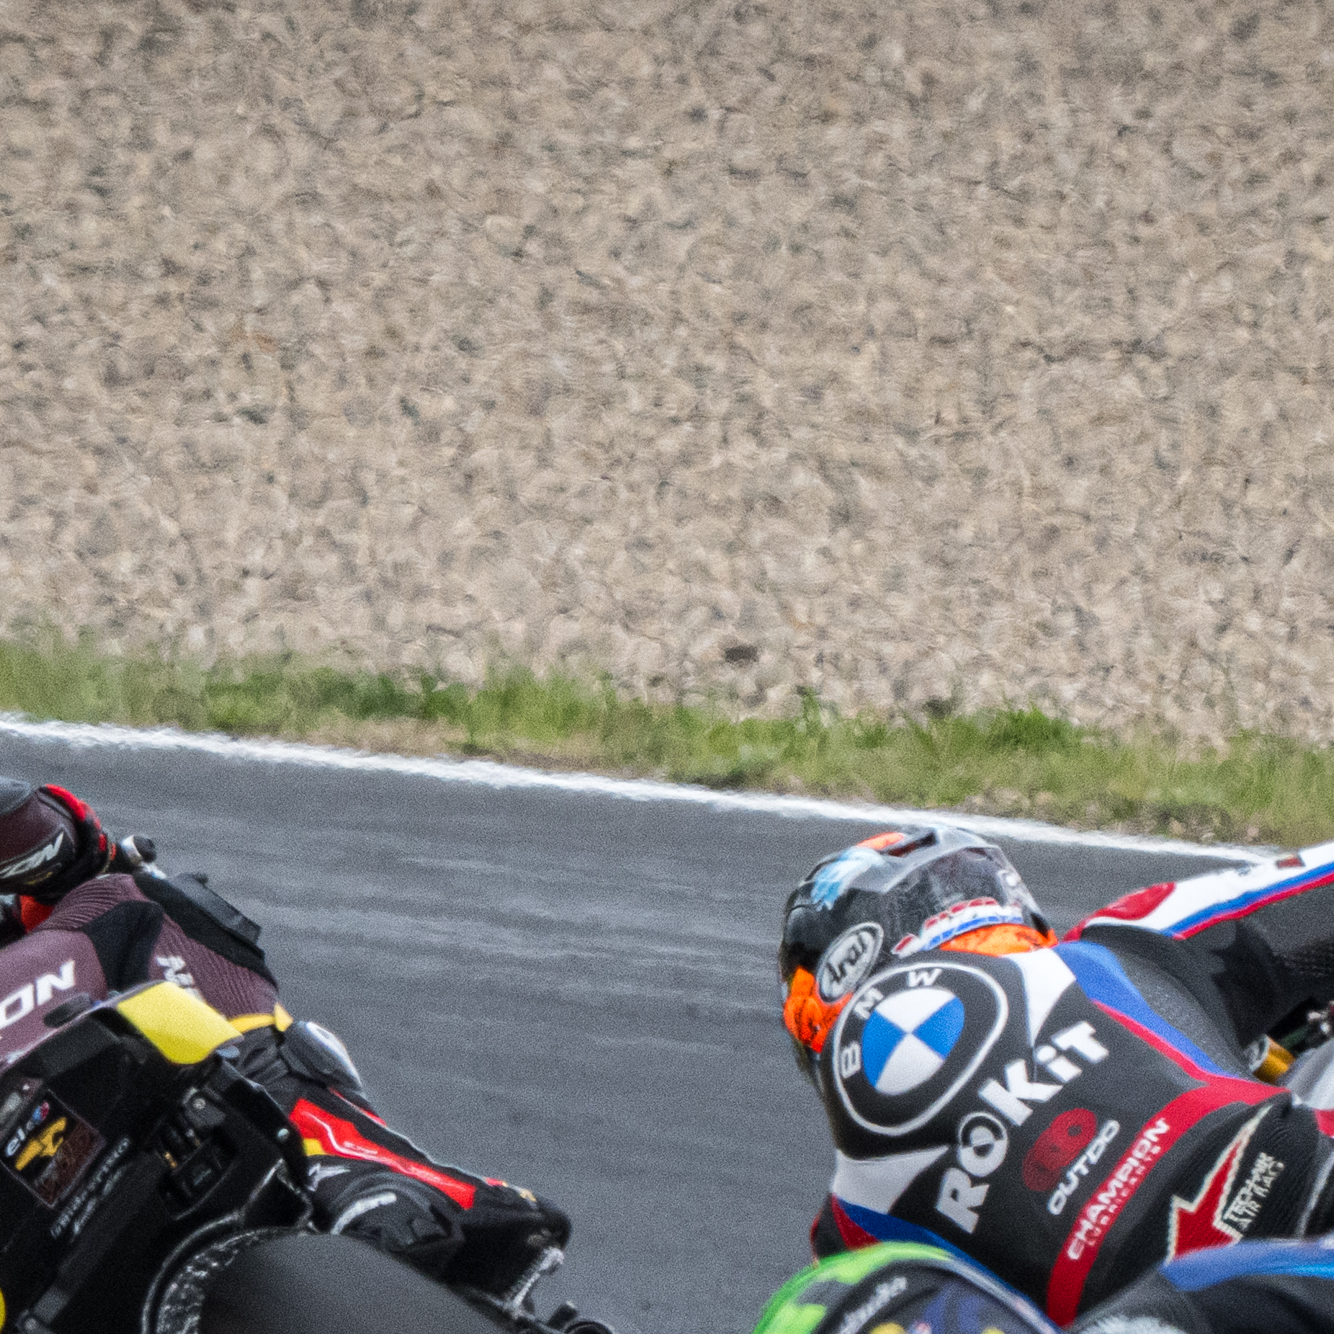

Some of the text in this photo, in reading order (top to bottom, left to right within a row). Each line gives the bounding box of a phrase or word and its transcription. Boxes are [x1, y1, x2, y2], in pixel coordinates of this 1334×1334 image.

[824, 930, 869, 986] Arai
[1047, 1119, 1120, 1215] OUTDO
[1067, 1118, 1170, 1261] CHAMPION
